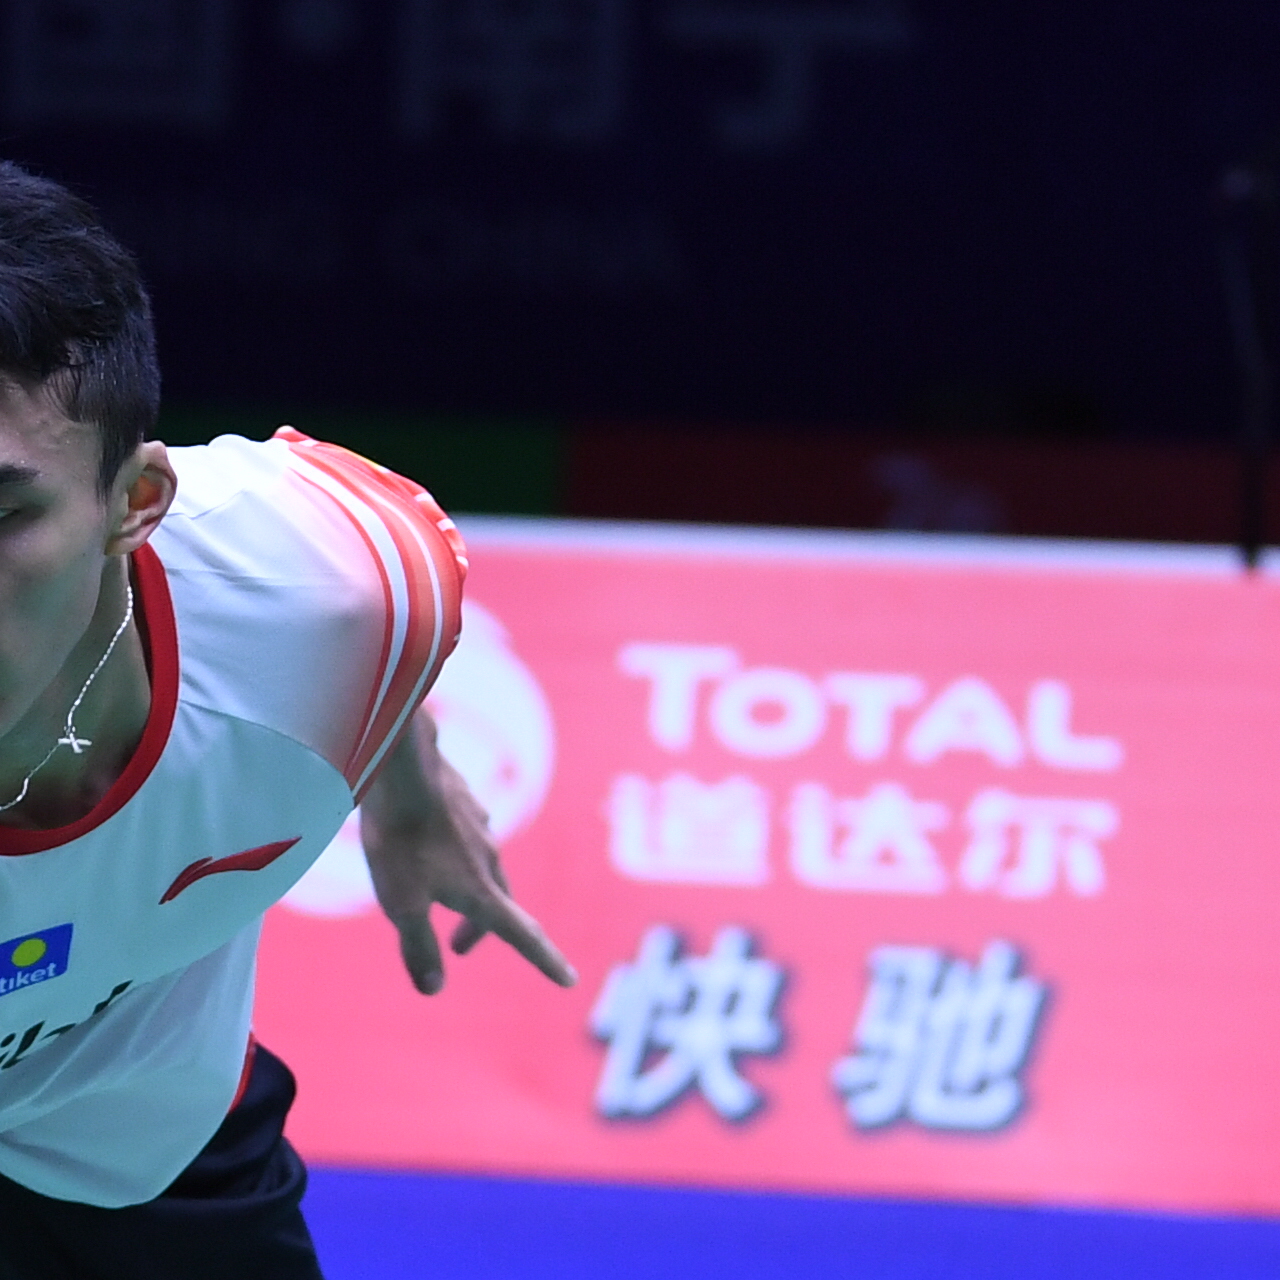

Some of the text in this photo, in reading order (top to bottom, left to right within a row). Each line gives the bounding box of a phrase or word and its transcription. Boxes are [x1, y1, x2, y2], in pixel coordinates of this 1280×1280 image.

[618, 640, 1124, 772] TOTAL
[608, 771, 1120, 897] 道达尔
